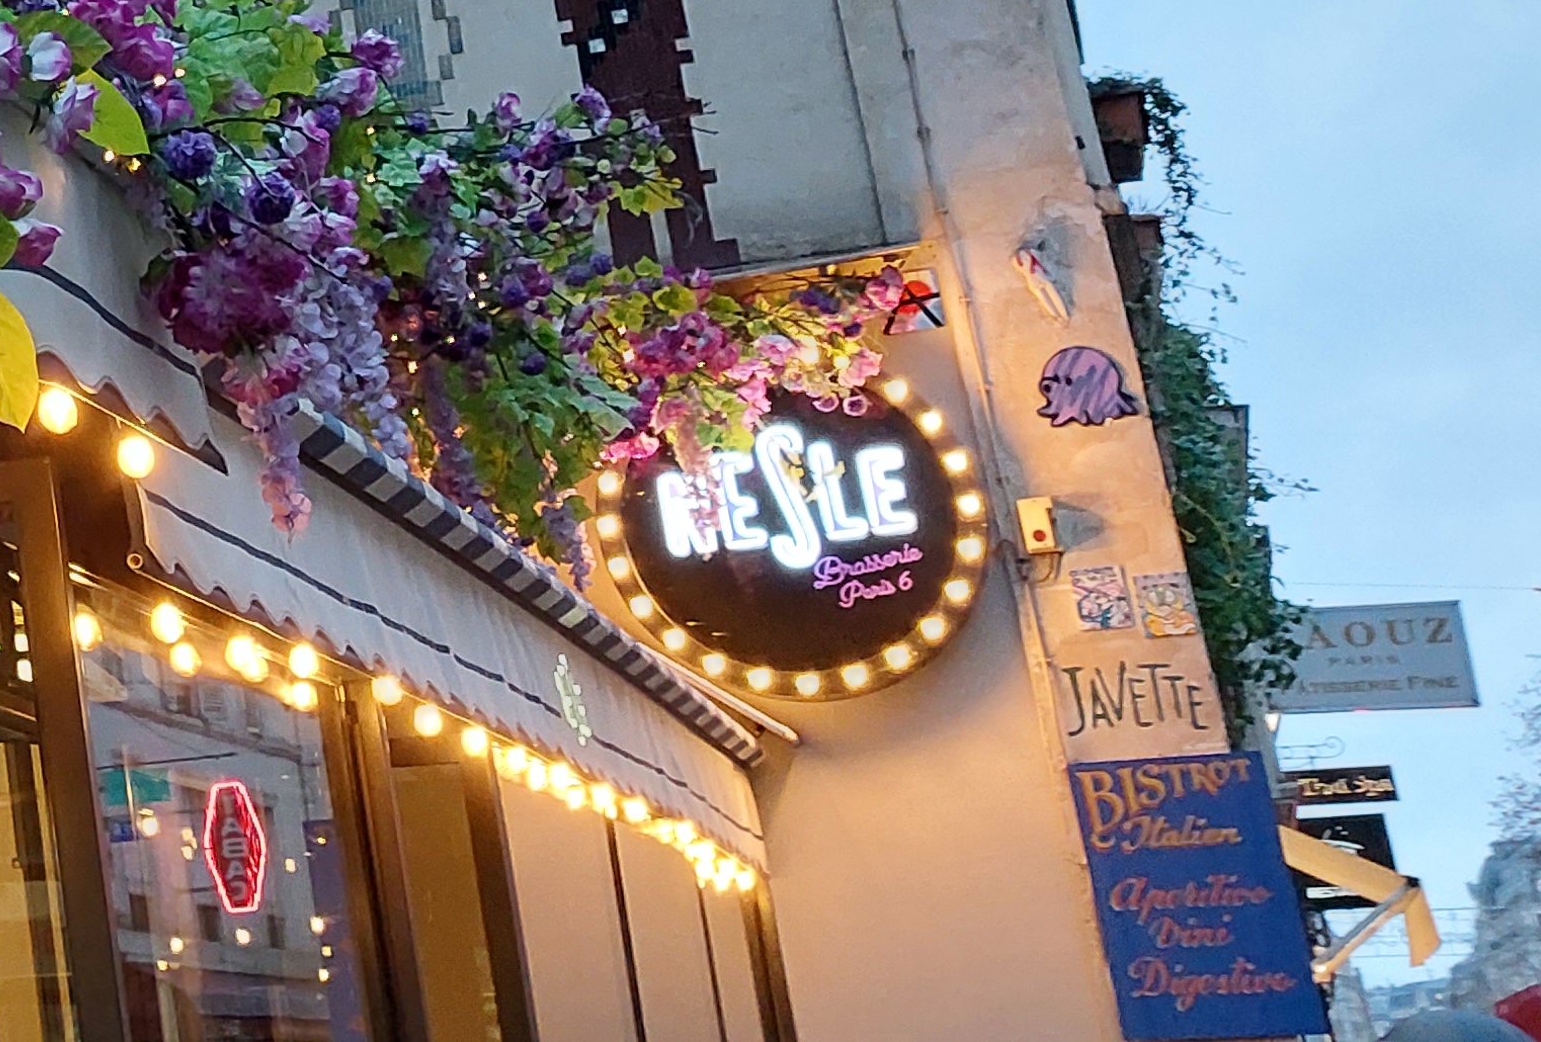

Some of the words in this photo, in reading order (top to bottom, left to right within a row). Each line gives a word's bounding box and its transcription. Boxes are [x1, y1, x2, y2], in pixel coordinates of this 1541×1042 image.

[655, 422, 918, 570] NESLE
[813, 543, 923, 589] Brasserie
[839, 579, 896, 608] Paris
[898, 570, 913, 591] 6
[1303, 617, 1453, 649] AOUZ
[1062, 661, 1209, 737] JAVETTE
[1075, 758, 1251, 854] BISTROT
